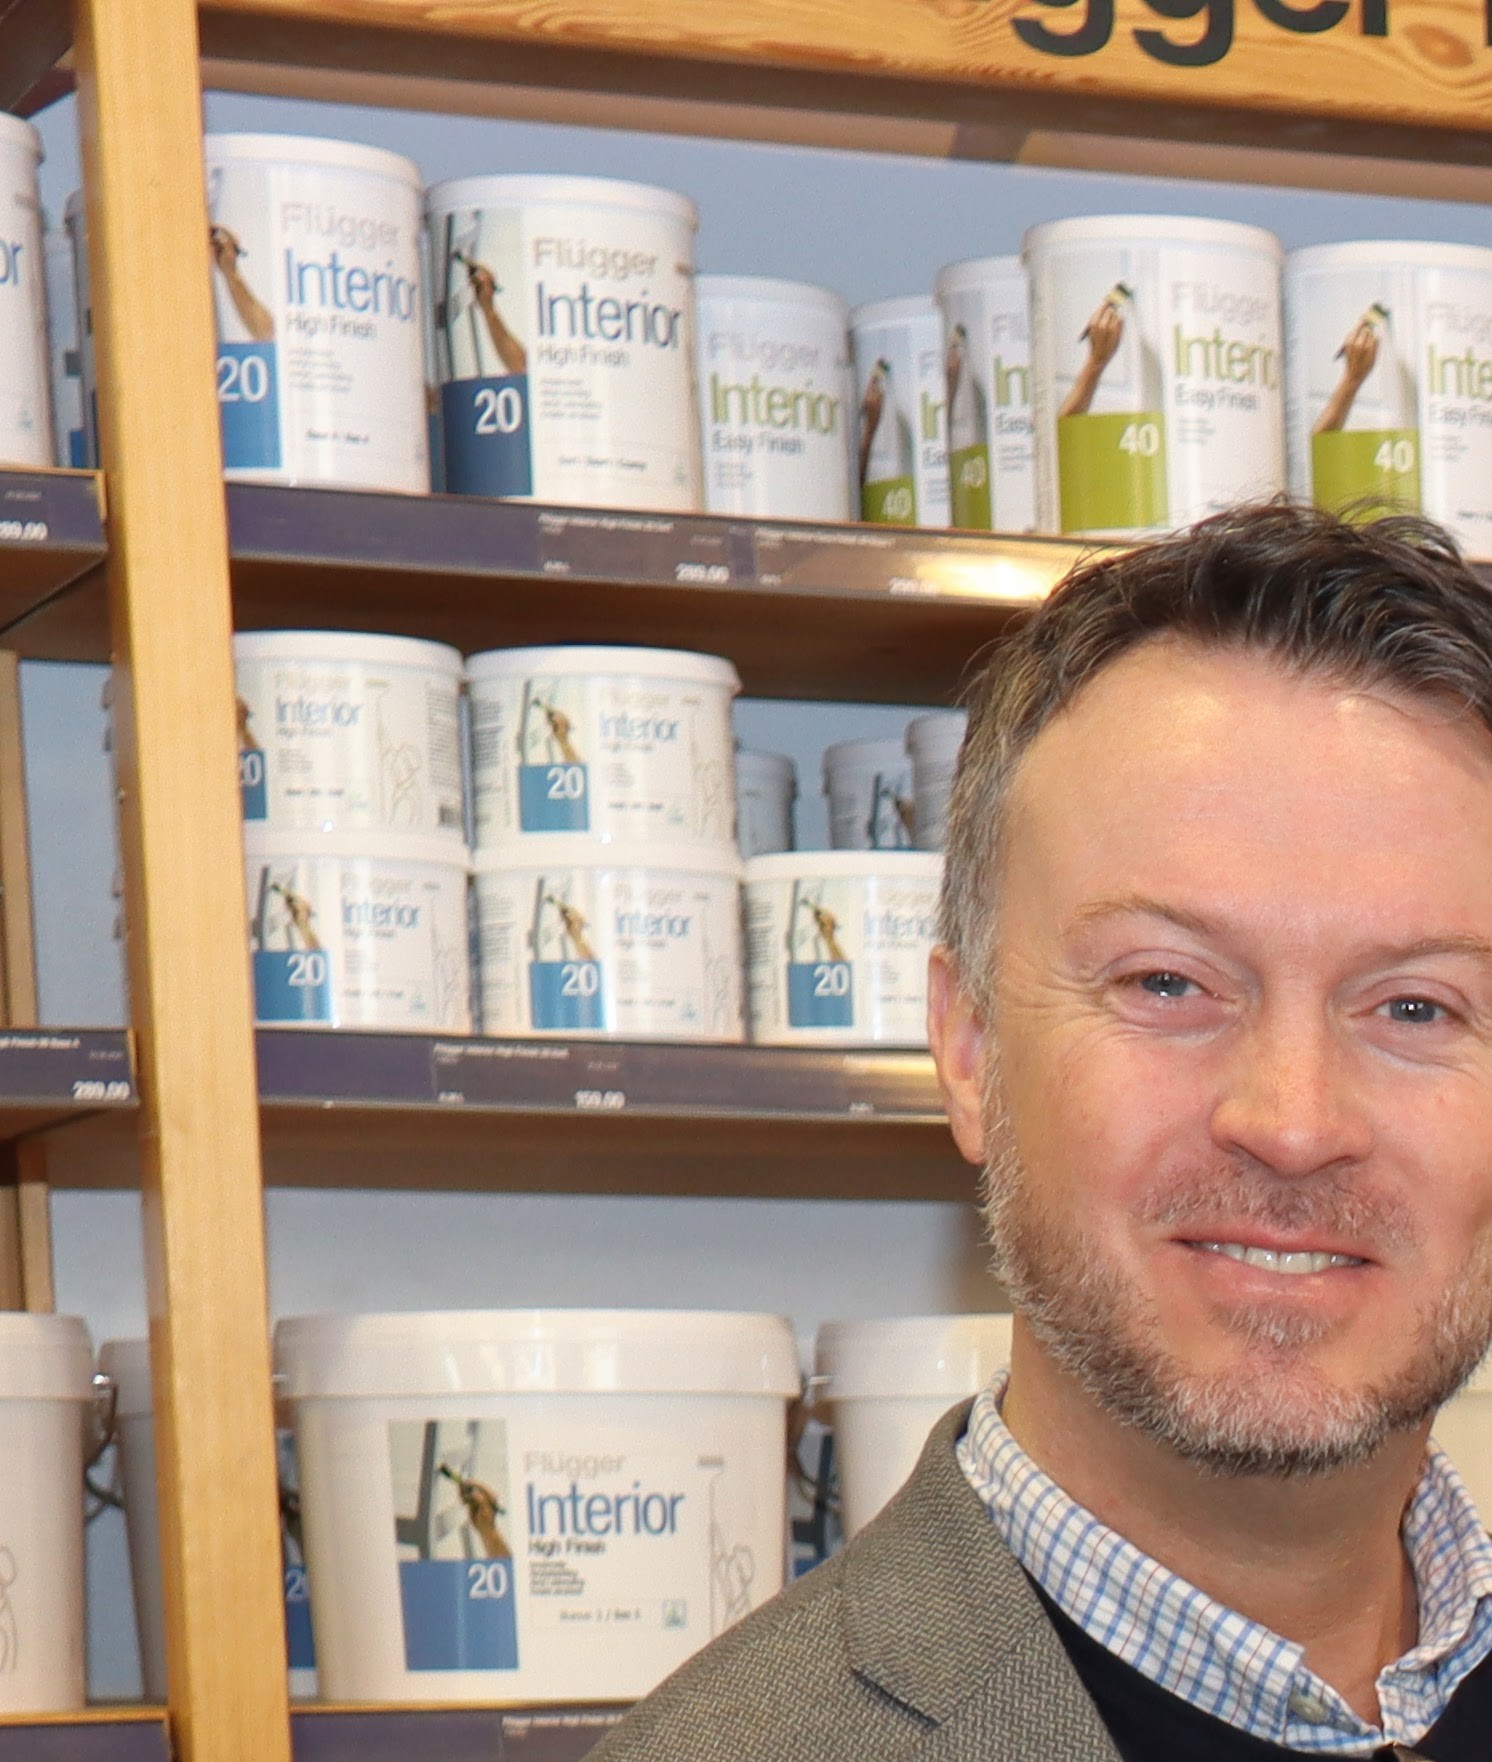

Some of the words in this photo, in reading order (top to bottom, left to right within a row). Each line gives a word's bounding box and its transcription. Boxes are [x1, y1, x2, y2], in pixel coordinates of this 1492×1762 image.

[536, 282, 684, 350] Interior
[217, 355, 269, 402] 20
[475, 387, 523, 436] 20
[1118, 424, 1160, 457] 40
[1374, 440, 1416, 474] 40
[546, 765, 585, 800] 20
[286, 953, 325, 988] 20
[560, 963, 598, 997] 20
[813, 964, 850, 997] 20
[525, 1481, 686, 1536] Interior
[466, 1562, 508, 1600] 20
